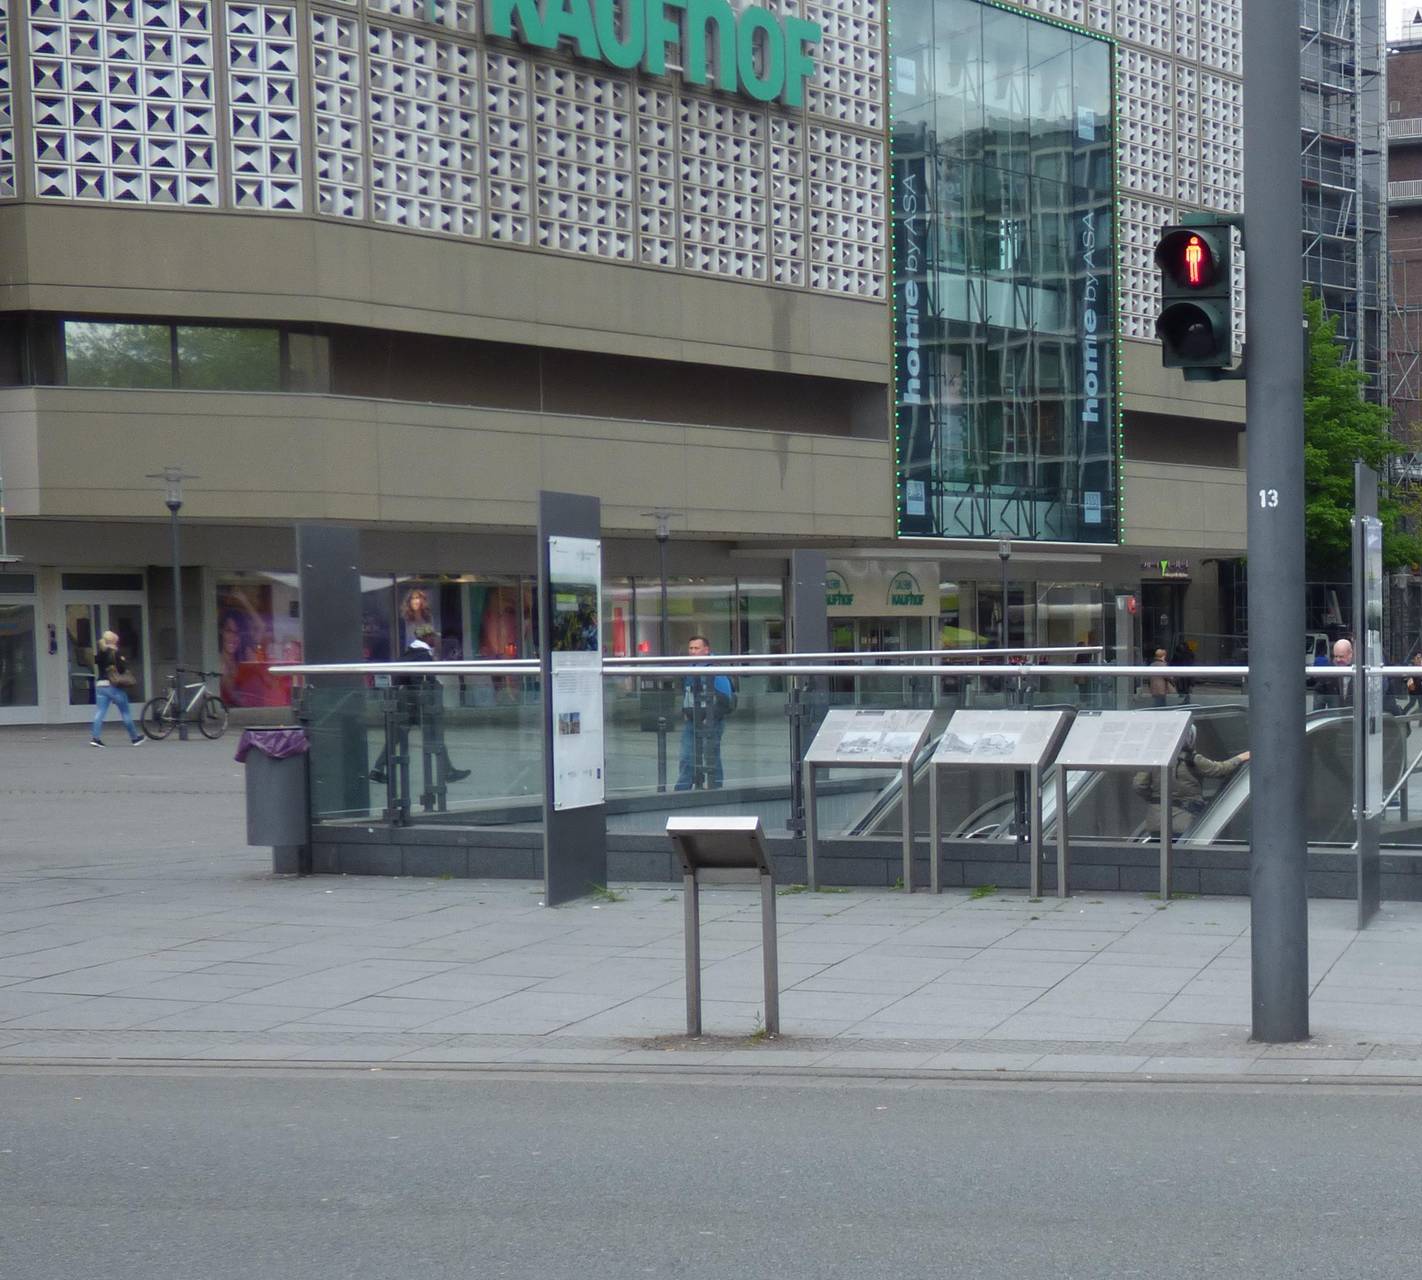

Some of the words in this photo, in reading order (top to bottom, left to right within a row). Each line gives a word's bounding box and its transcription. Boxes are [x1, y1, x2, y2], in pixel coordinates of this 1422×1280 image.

[902, 173, 917, 236] ASA
[904, 239, 921, 272] by
[1081, 212, 1096, 268] ASA
[1083, 271, 1099, 302] by
[903, 279, 921, 404] home
[1082, 309, 1099, 422] home
[1259, 489, 1279, 508] 13
